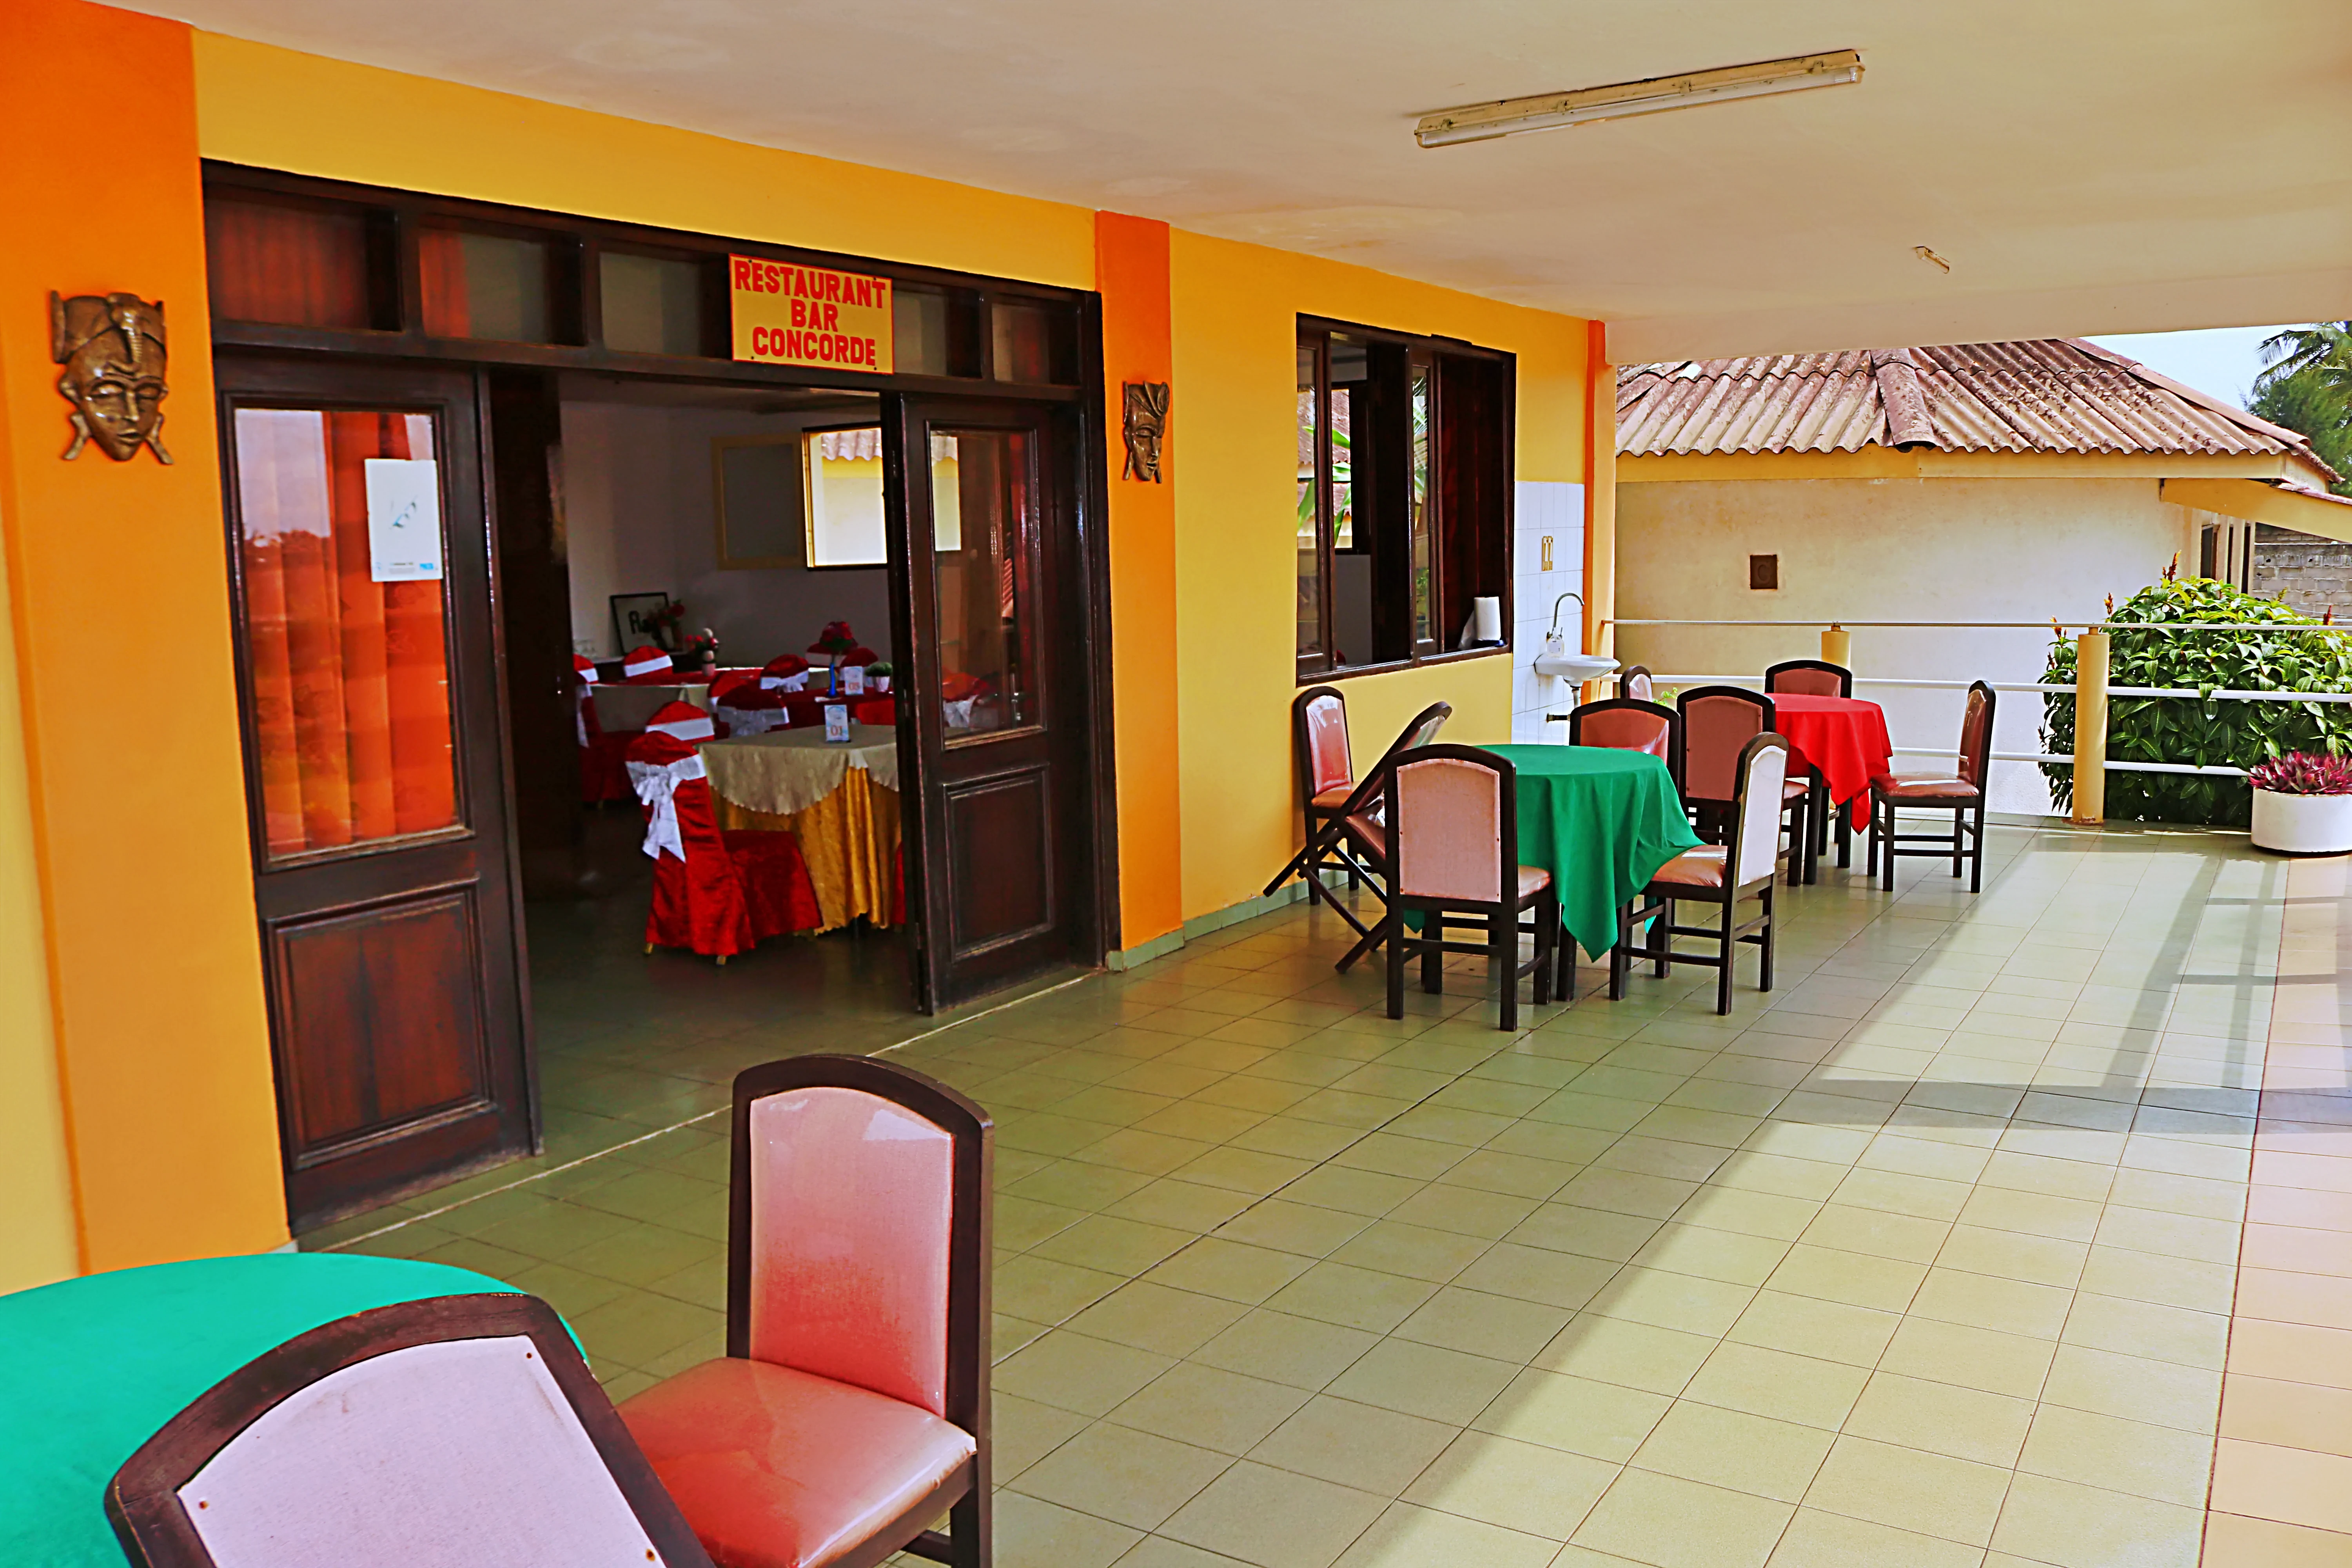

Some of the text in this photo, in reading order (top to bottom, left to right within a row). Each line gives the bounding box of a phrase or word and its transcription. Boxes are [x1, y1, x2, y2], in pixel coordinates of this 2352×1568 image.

[734, 260, 886, 309] RESTAURANT
[791, 299, 838, 332] BAR
[753, 327, 876, 366] CONCORDE
[831, 725, 843, 736] 01
